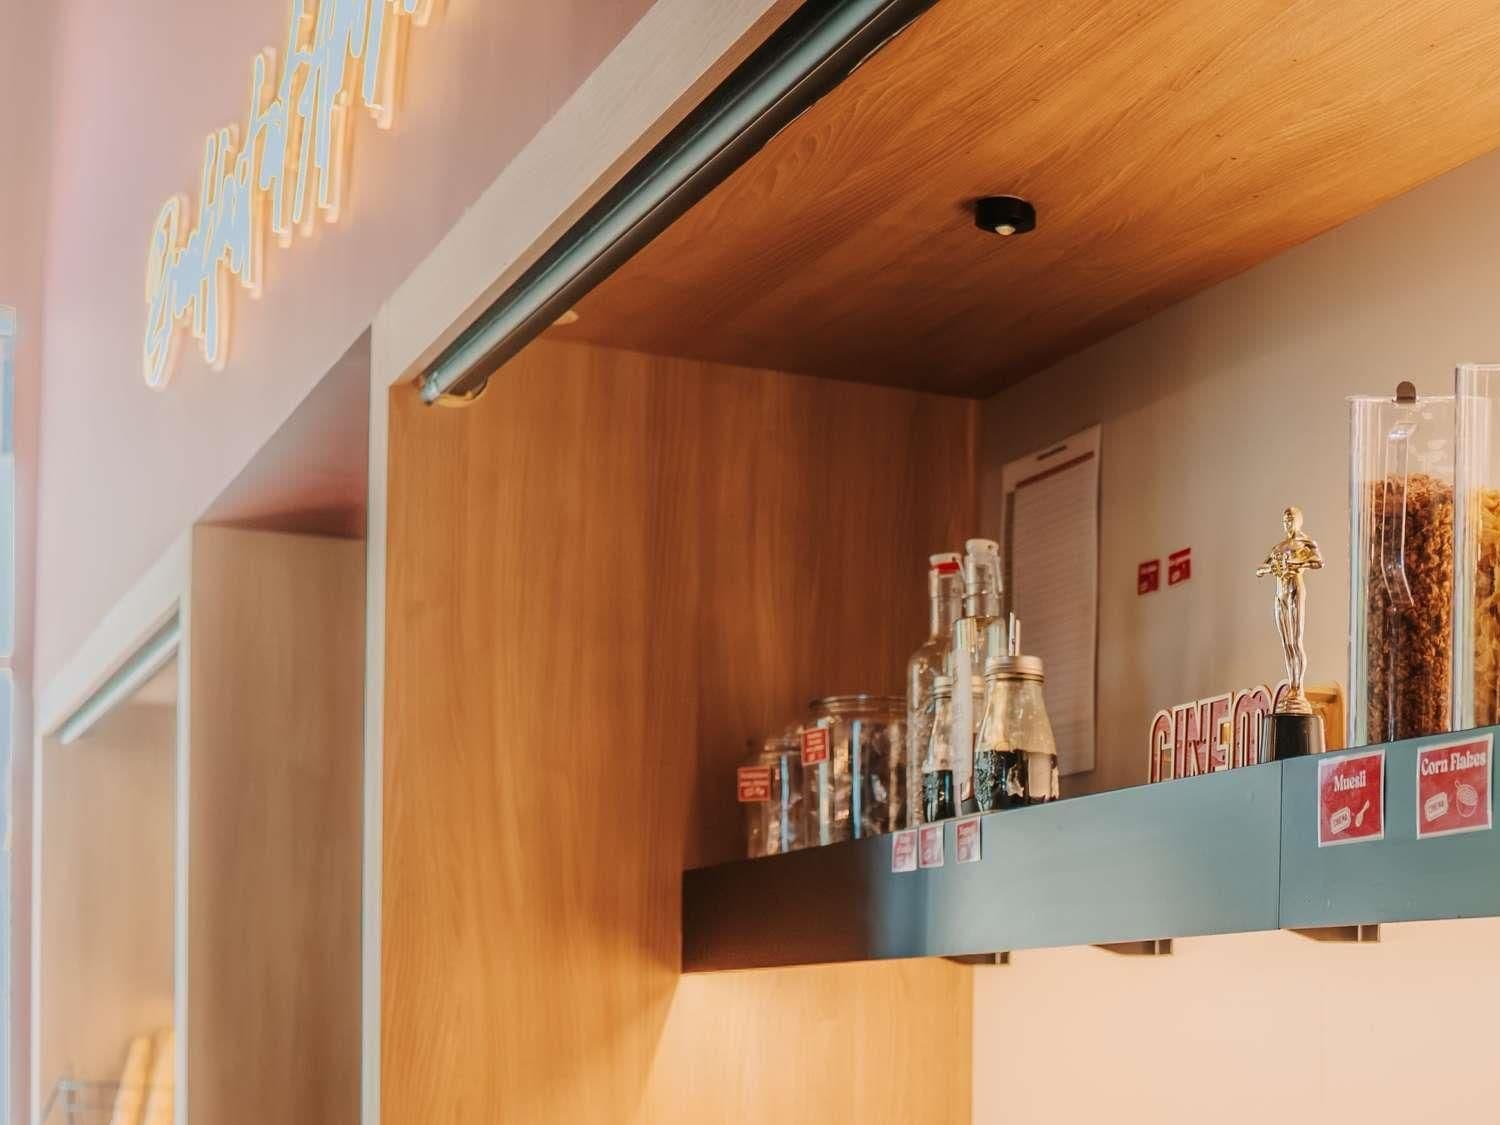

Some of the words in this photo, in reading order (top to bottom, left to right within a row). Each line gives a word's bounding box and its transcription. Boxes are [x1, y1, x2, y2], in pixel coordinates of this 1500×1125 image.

[1421, 758, 1448, 776] Corn
[1450, 750, 1487, 772] Flakes
[1333, 769, 1367, 793] Muesli
